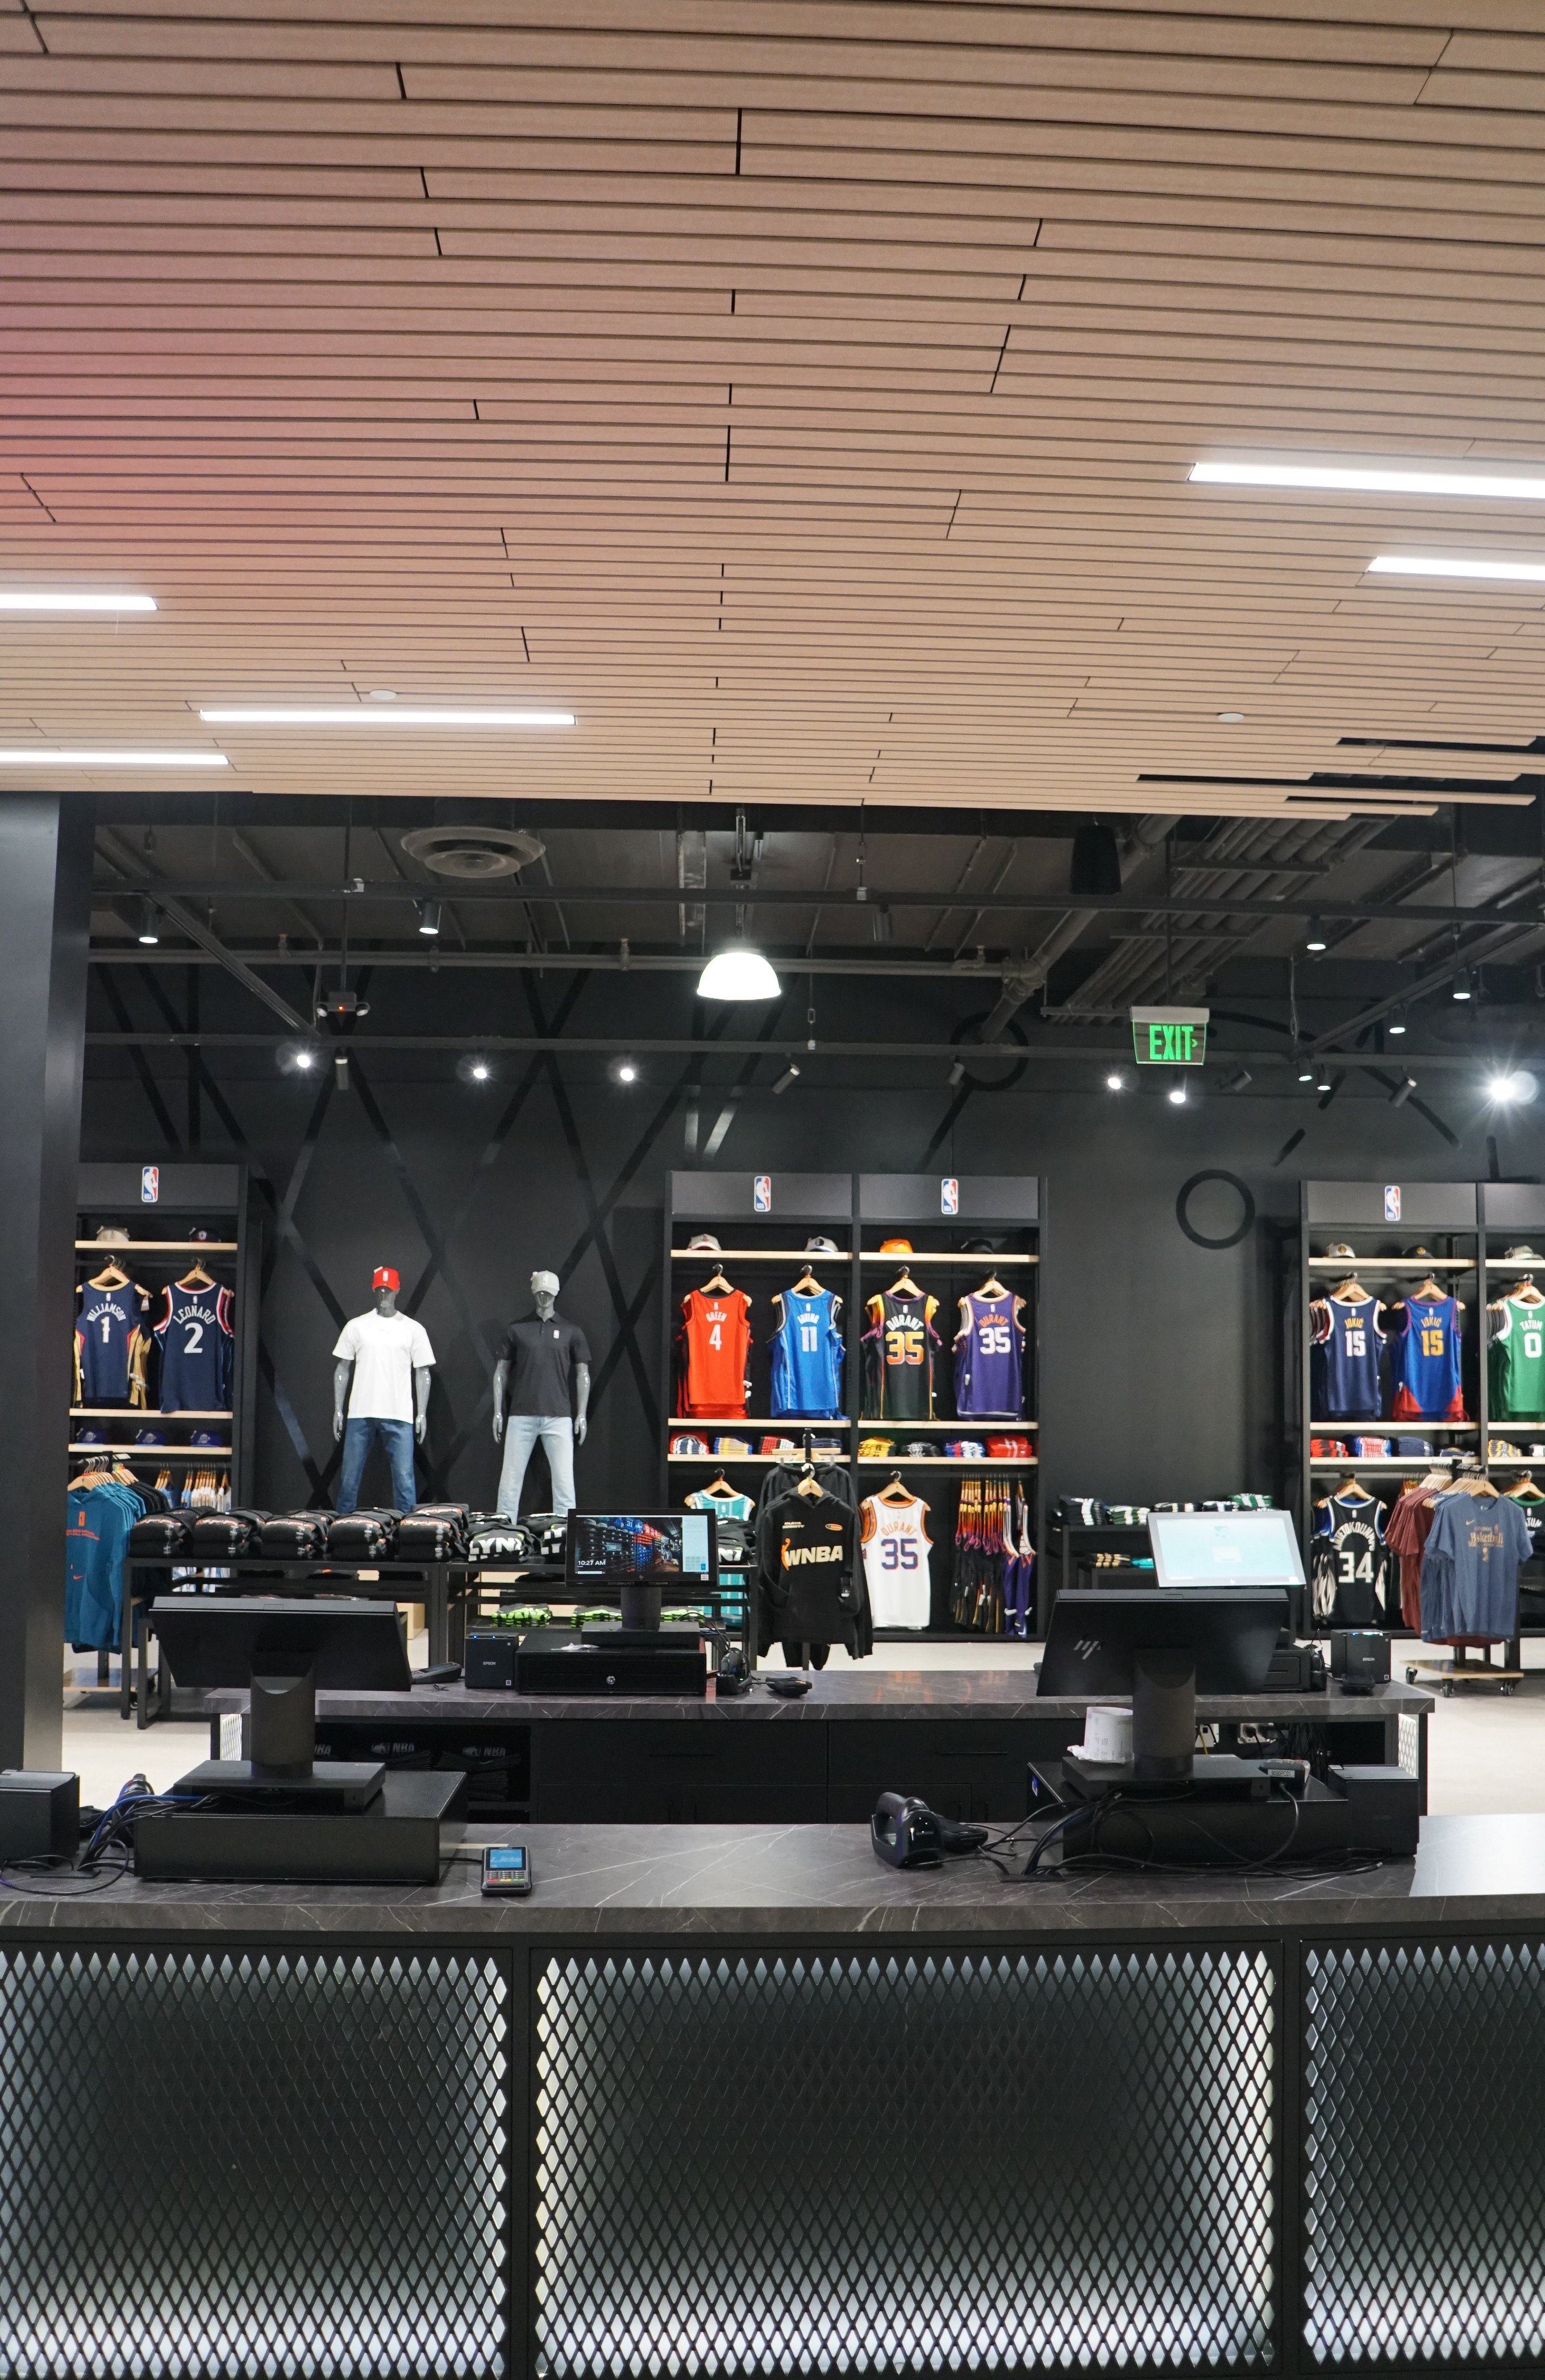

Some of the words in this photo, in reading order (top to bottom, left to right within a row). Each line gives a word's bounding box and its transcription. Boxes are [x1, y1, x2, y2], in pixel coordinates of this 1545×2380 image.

[1149, 1024, 1194, 1061] EXIT
[86, 1303, 127, 1322] WILLIAMSON
[173, 1305, 216, 1325] LEONARD
[705, 1311, 727, 1322] GREEN
[885, 1314, 924, 1331] DURANT
[978, 1314, 1009, 1328] DURANT
[101, 1316, 110, 1343] 1
[1519, 1319, 1543, 1331] TATUM
[184, 1322, 203, 1353] 2
[709, 1324, 722, 1351] 4
[800, 1326, 818, 1352] 11
[885, 1331, 924, 1365] 35
[978, 1326, 1011, 1354] 35
[1344, 1331, 1366, 1357] 15
[1421, 1329, 1444, 1357] 15
[1524, 1332, 1542, 1358] 0
[881, 1521, 918, 1536] DURANT
[1525, 1516, 1542, 1528] TUM
[1469, 1532, 1504, 1544] Bsketbll
[784, 1545, 843, 1566] WNBA
[881, 1539, 919, 1570] 35
[1338, 1552, 1374, 1583] 34
[392, 1743, 415, 1753] NBA
[484, 1747, 506, 1757] NBA
